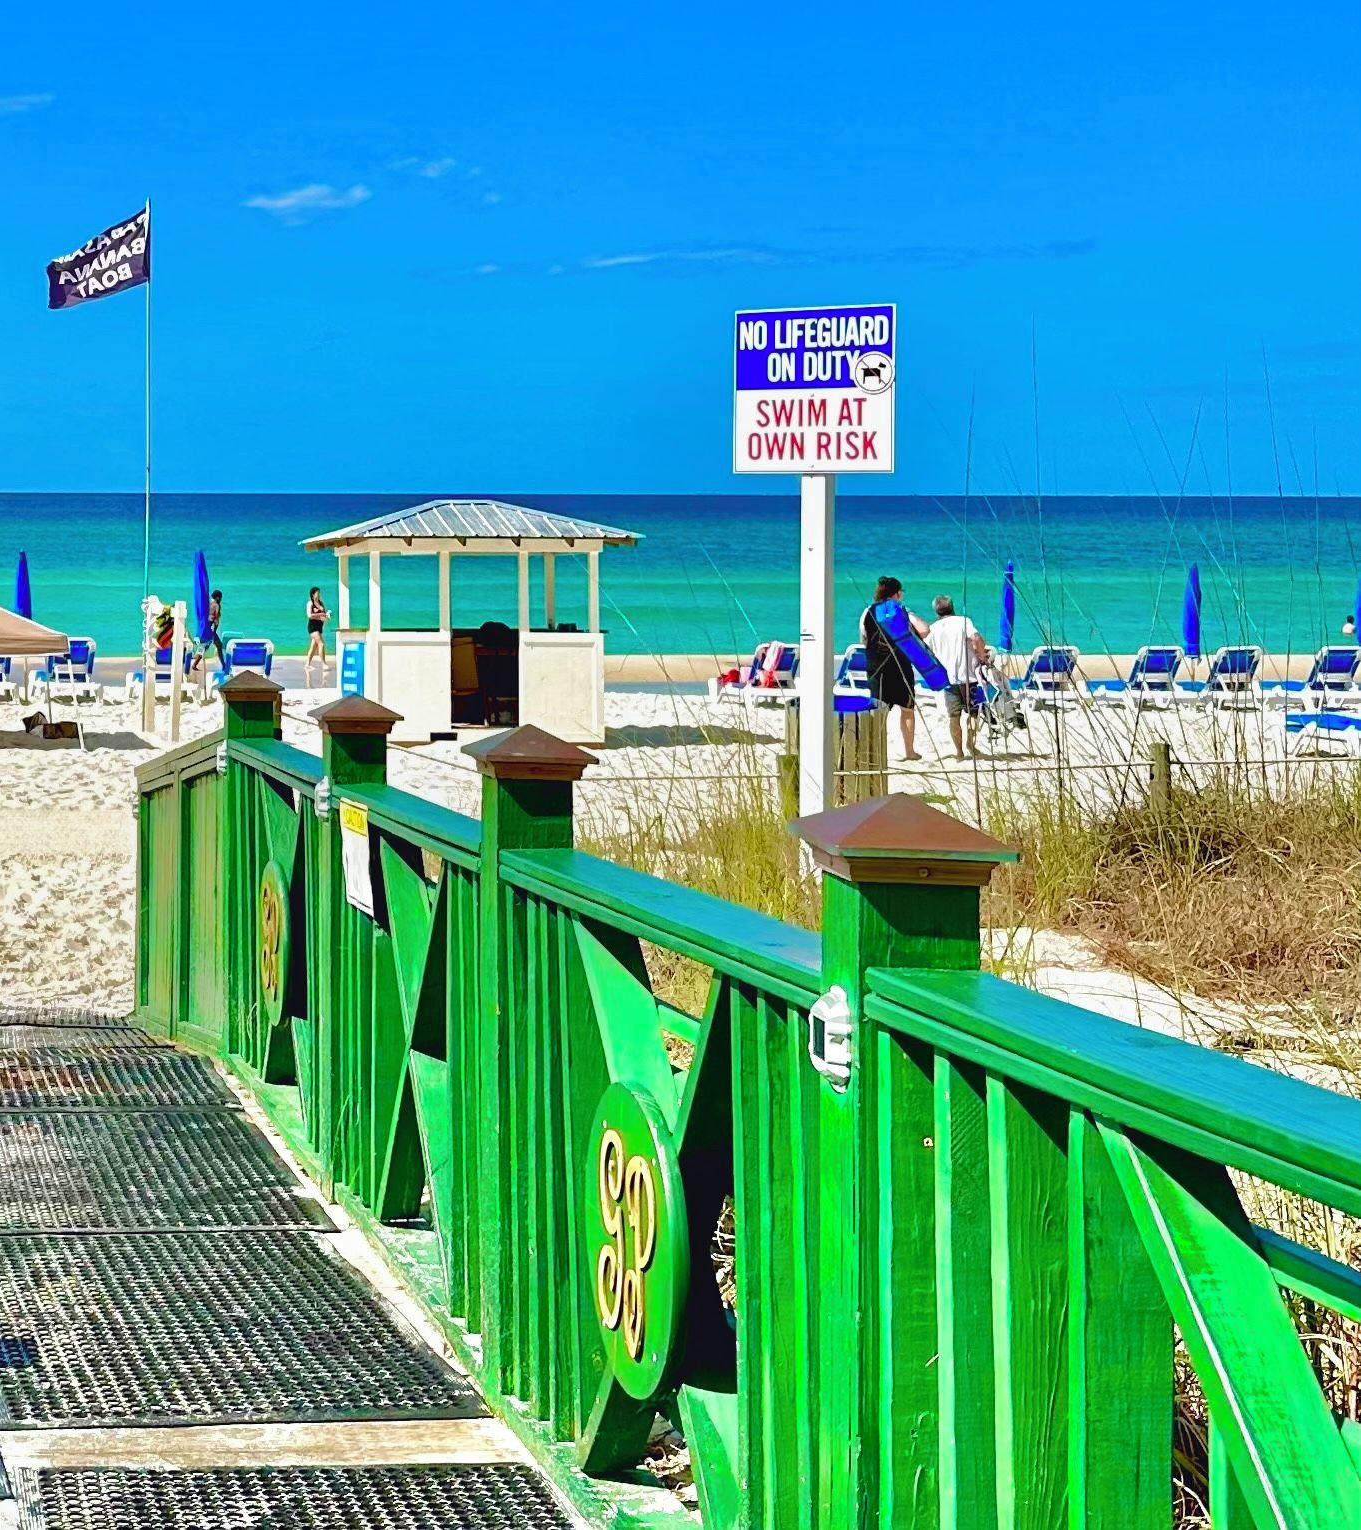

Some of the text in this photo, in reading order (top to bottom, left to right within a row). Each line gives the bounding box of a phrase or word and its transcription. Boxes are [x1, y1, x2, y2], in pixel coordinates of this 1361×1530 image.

[739, 315, 890, 350] NO LIFEGUARD
[767, 350, 860, 382] ON DUTY
[756, 397, 867, 428] SWIM AT
[748, 430, 878, 460] OWN RISK
